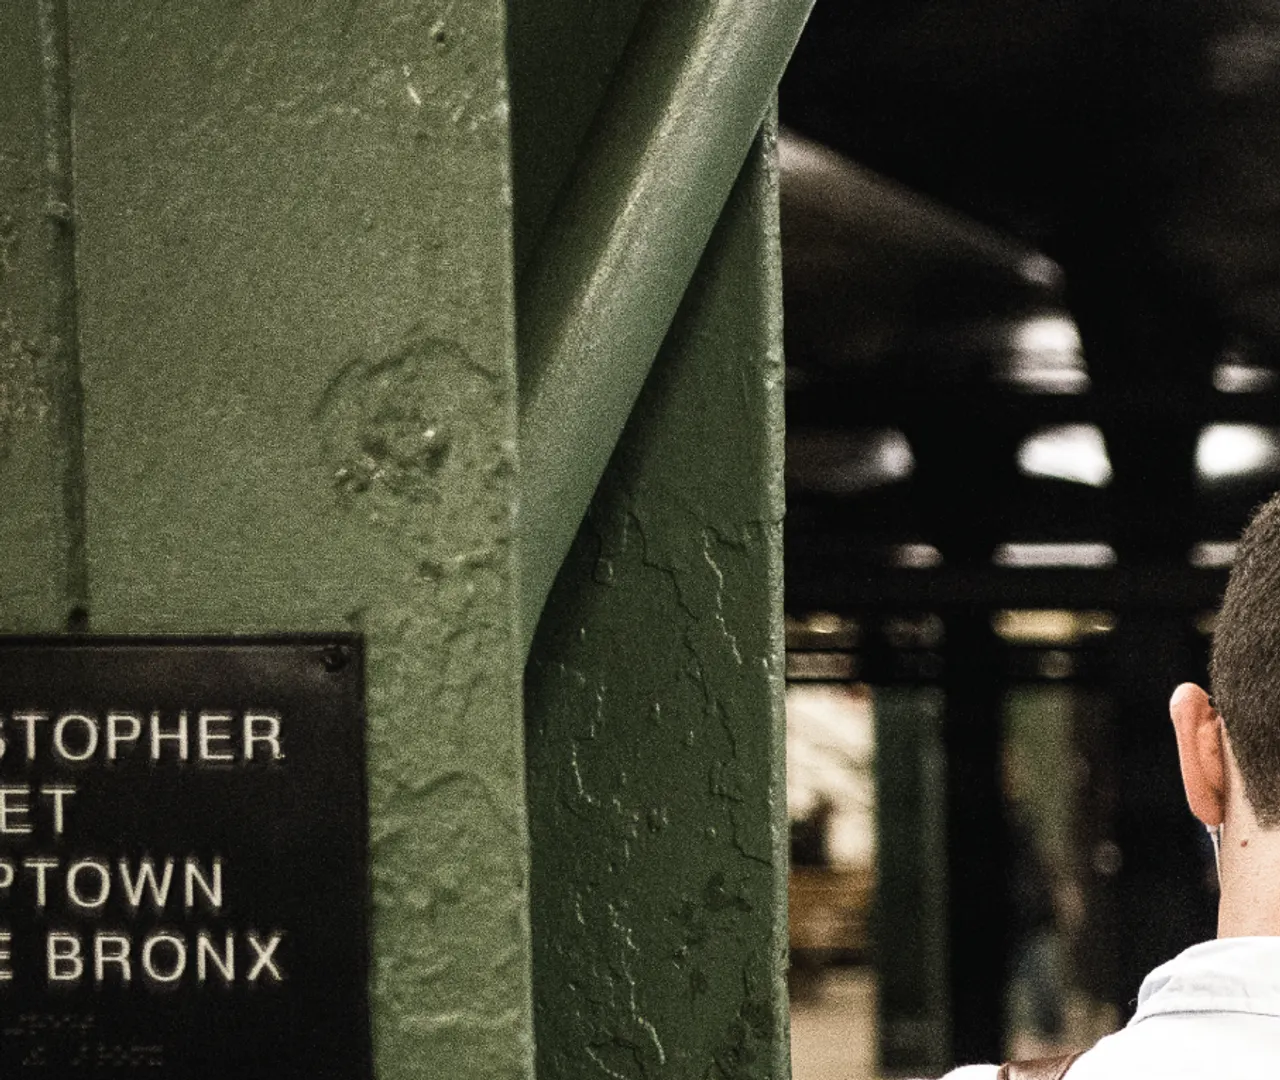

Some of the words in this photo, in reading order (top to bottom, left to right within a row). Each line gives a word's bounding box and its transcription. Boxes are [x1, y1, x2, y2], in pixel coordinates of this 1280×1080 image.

[0, 713, 284, 760] TOPHER
[0, 787, 76, 833] ET
[47, 933, 283, 981] BRONX
